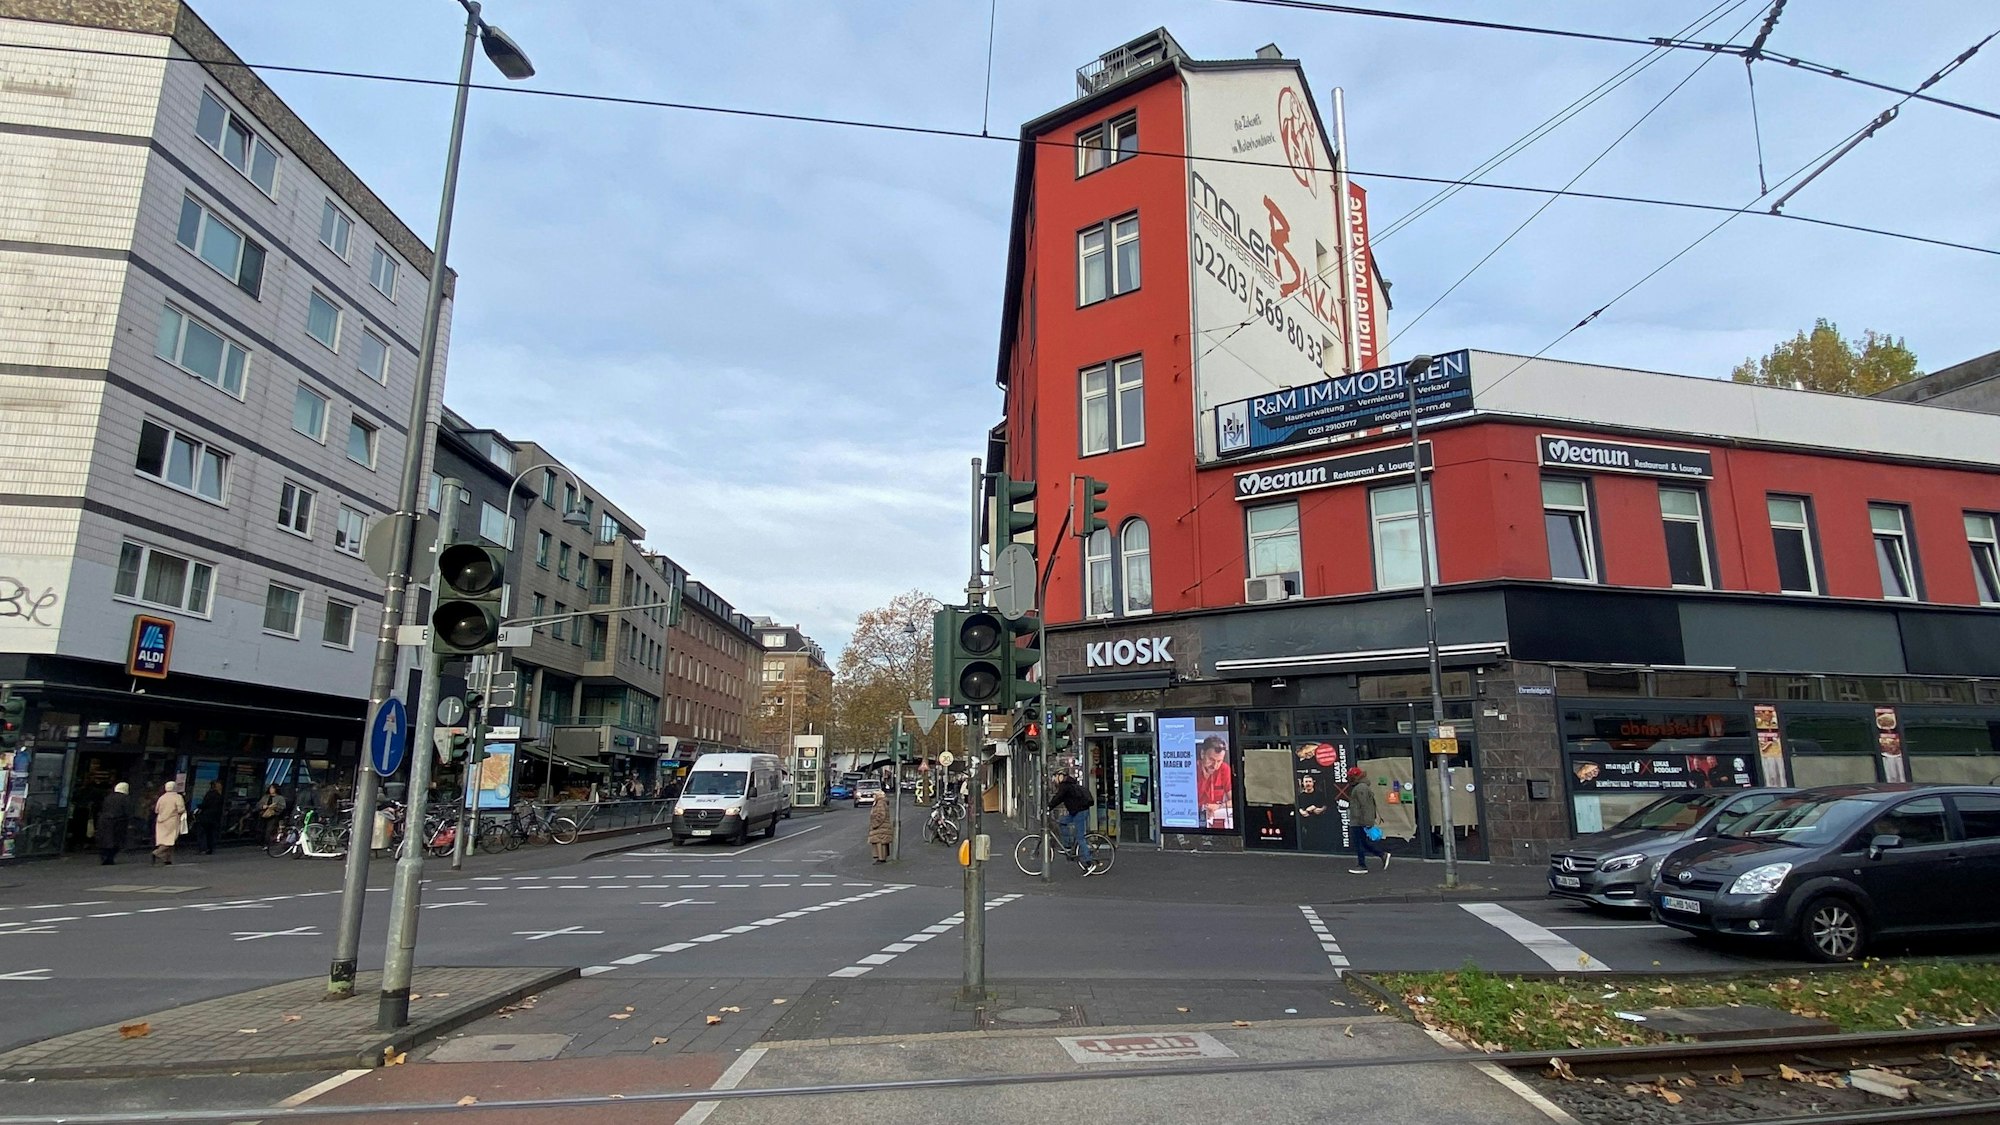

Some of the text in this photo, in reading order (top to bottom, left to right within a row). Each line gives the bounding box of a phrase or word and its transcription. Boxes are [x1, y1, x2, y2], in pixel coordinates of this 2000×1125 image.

[1287, 316, 1304, 353] 80
[1307, 334, 1323, 369] 33
[1253, 392, 1297, 419] R&M
[1284, 402, 1345, 423] Hausverwaltung
[1357, 391, 1405, 408] Vermietung
[1417, 381, 1451, 394] Verkauf
[1308, 424, 1324, 435] 0221
[1548, 439, 1703, 475] Mecnun Restaurant & Lounge
[1239, 465, 1327, 495] Mecnun
[1333, 467, 1375, 480] Restaurant
[1377, 463, 1385, 473] &
[138, 649, 164, 664] ALDI
[1086, 636, 1175, 668] KIOSK
[803, 759, 811, 768] U
[1334, 761, 1342, 783] LUKAS
